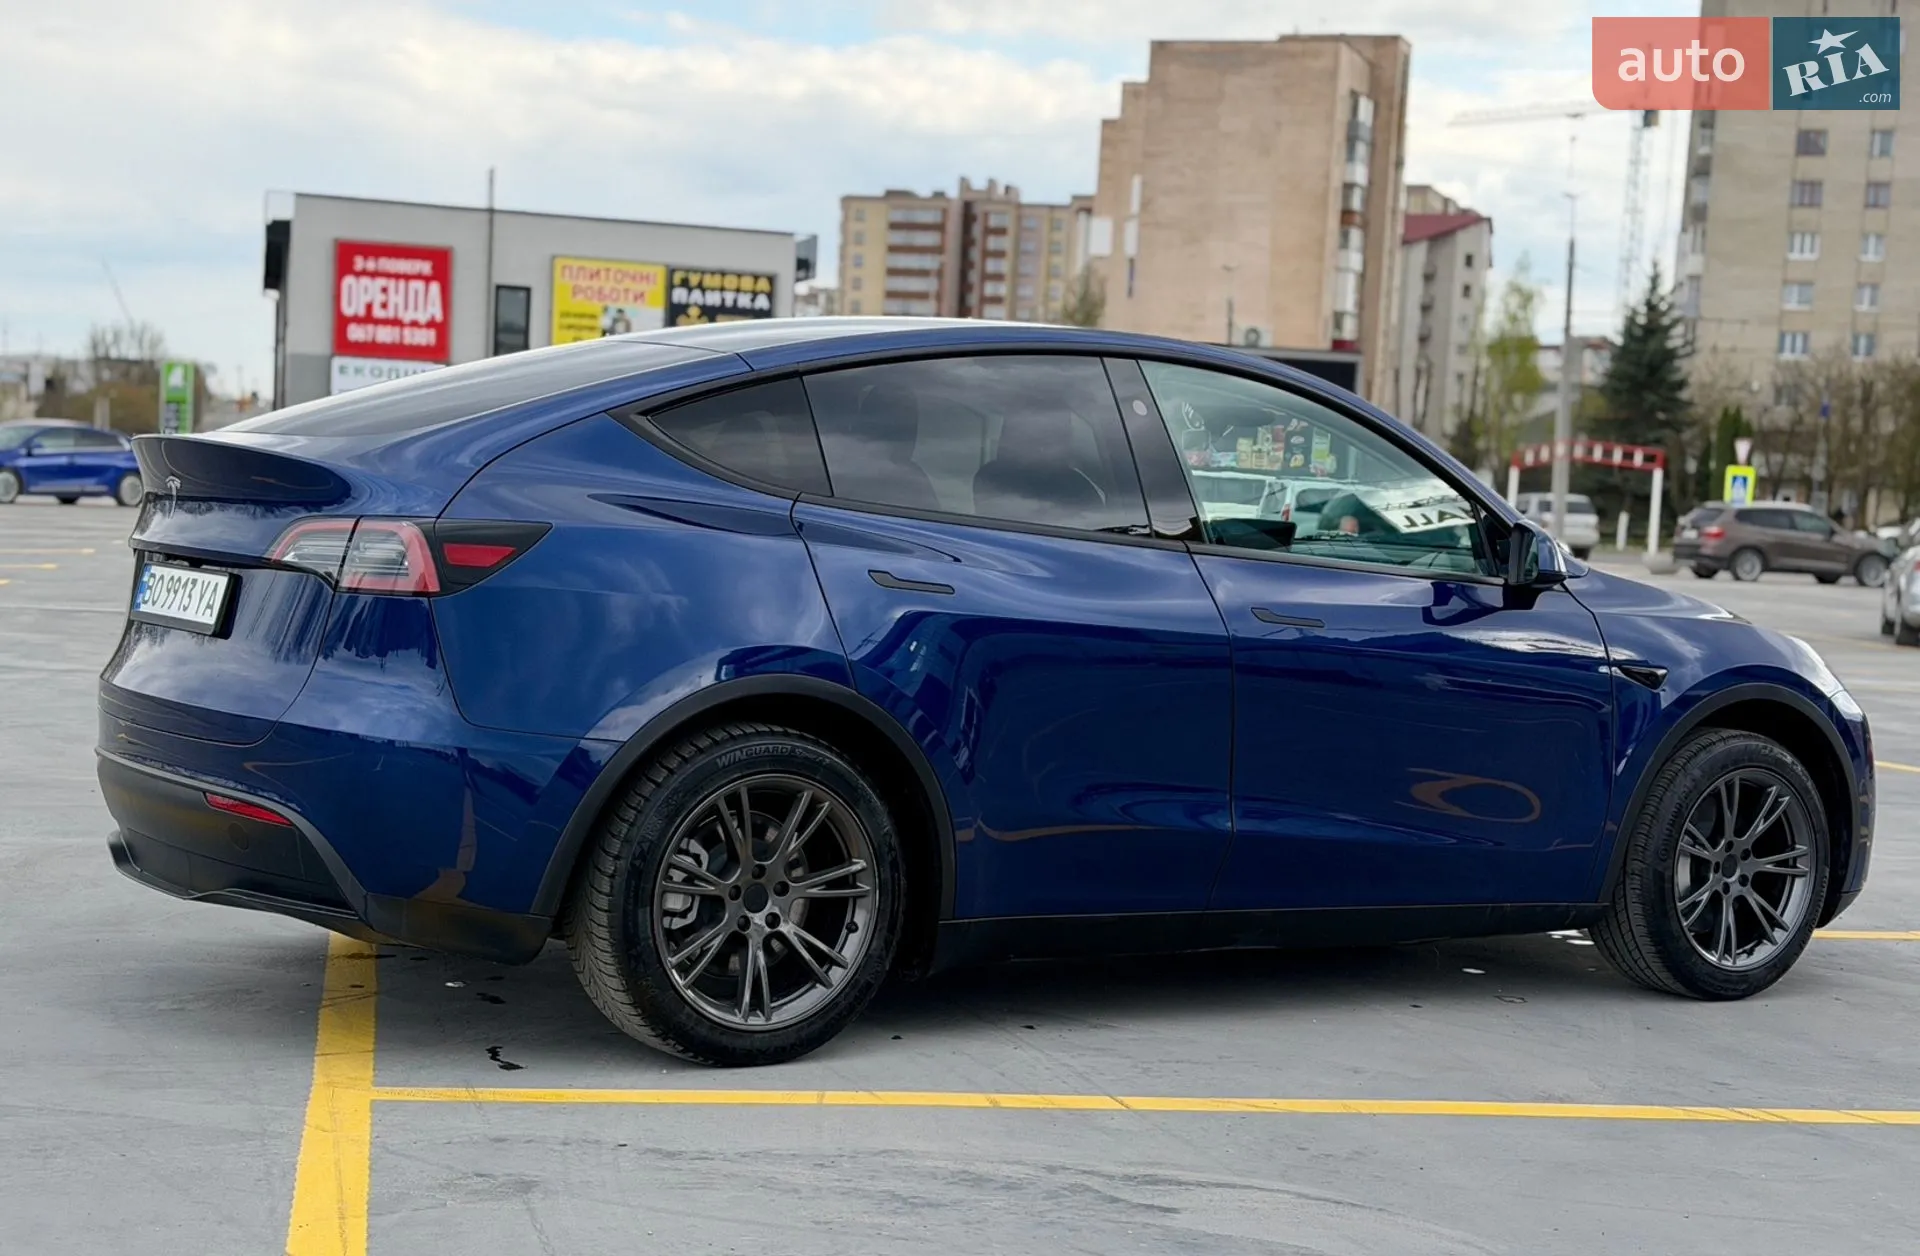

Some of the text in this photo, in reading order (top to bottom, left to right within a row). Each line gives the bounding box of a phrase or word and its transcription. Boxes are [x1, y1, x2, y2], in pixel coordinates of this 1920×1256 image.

[560, 265, 657, 284] ПЛИТОЧНІ
[673, 270, 771, 291] ГУМОВА
[340, 274, 443, 324] ОРЕНДА
[571, 283, 646, 303] РОБОТИ
[672, 287, 770, 309] ПЛИТКА
[161, 575, 199, 612] 9913
[195, 579, 218, 617] YA
[716, 744, 793, 769] WINGUARD
